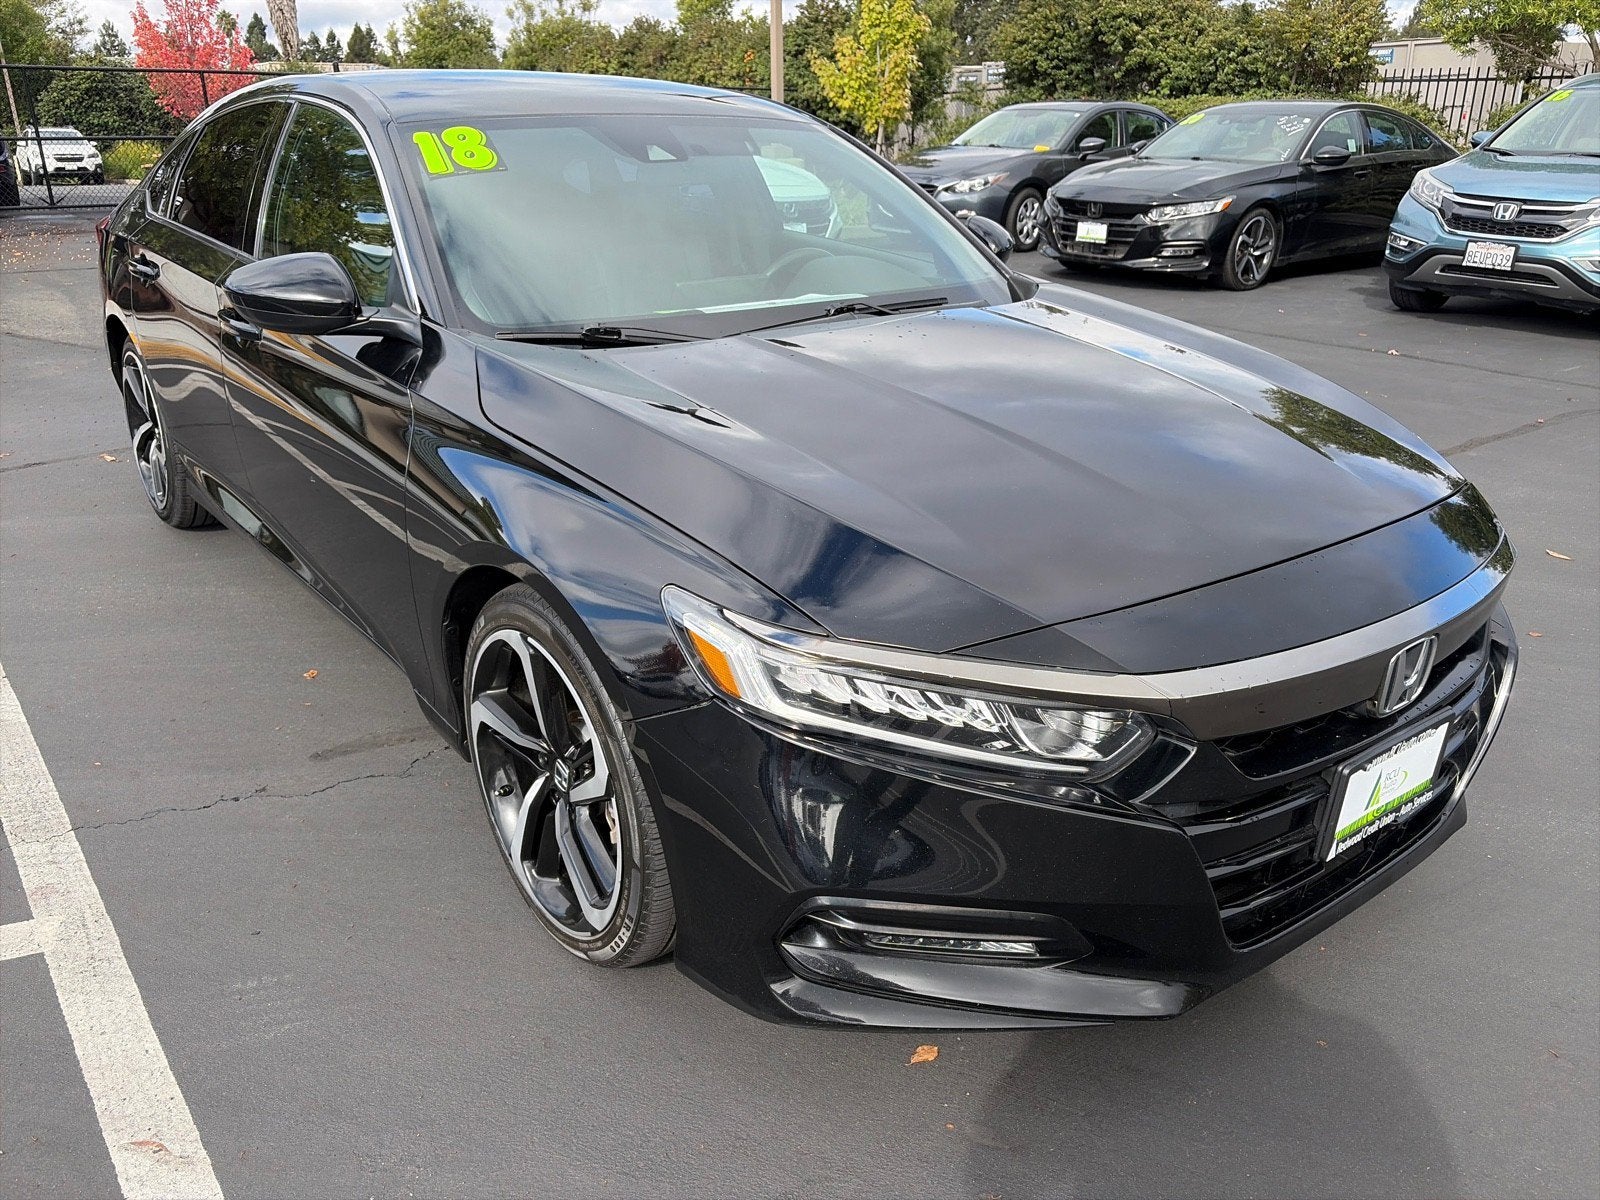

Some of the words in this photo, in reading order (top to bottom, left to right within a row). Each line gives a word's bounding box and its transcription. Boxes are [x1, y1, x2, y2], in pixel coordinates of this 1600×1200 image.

[412, 126, 498, 175] 18
[1466, 250, 1512, 267] 8EUP039
[1336, 832, 1363, 854] Redwood
[1363, 822, 1380, 839] Credit
[1380, 812, 1396, 828] Union
[1399, 803, 1413, 817] Auto
[1412, 791, 1433, 809] Services
